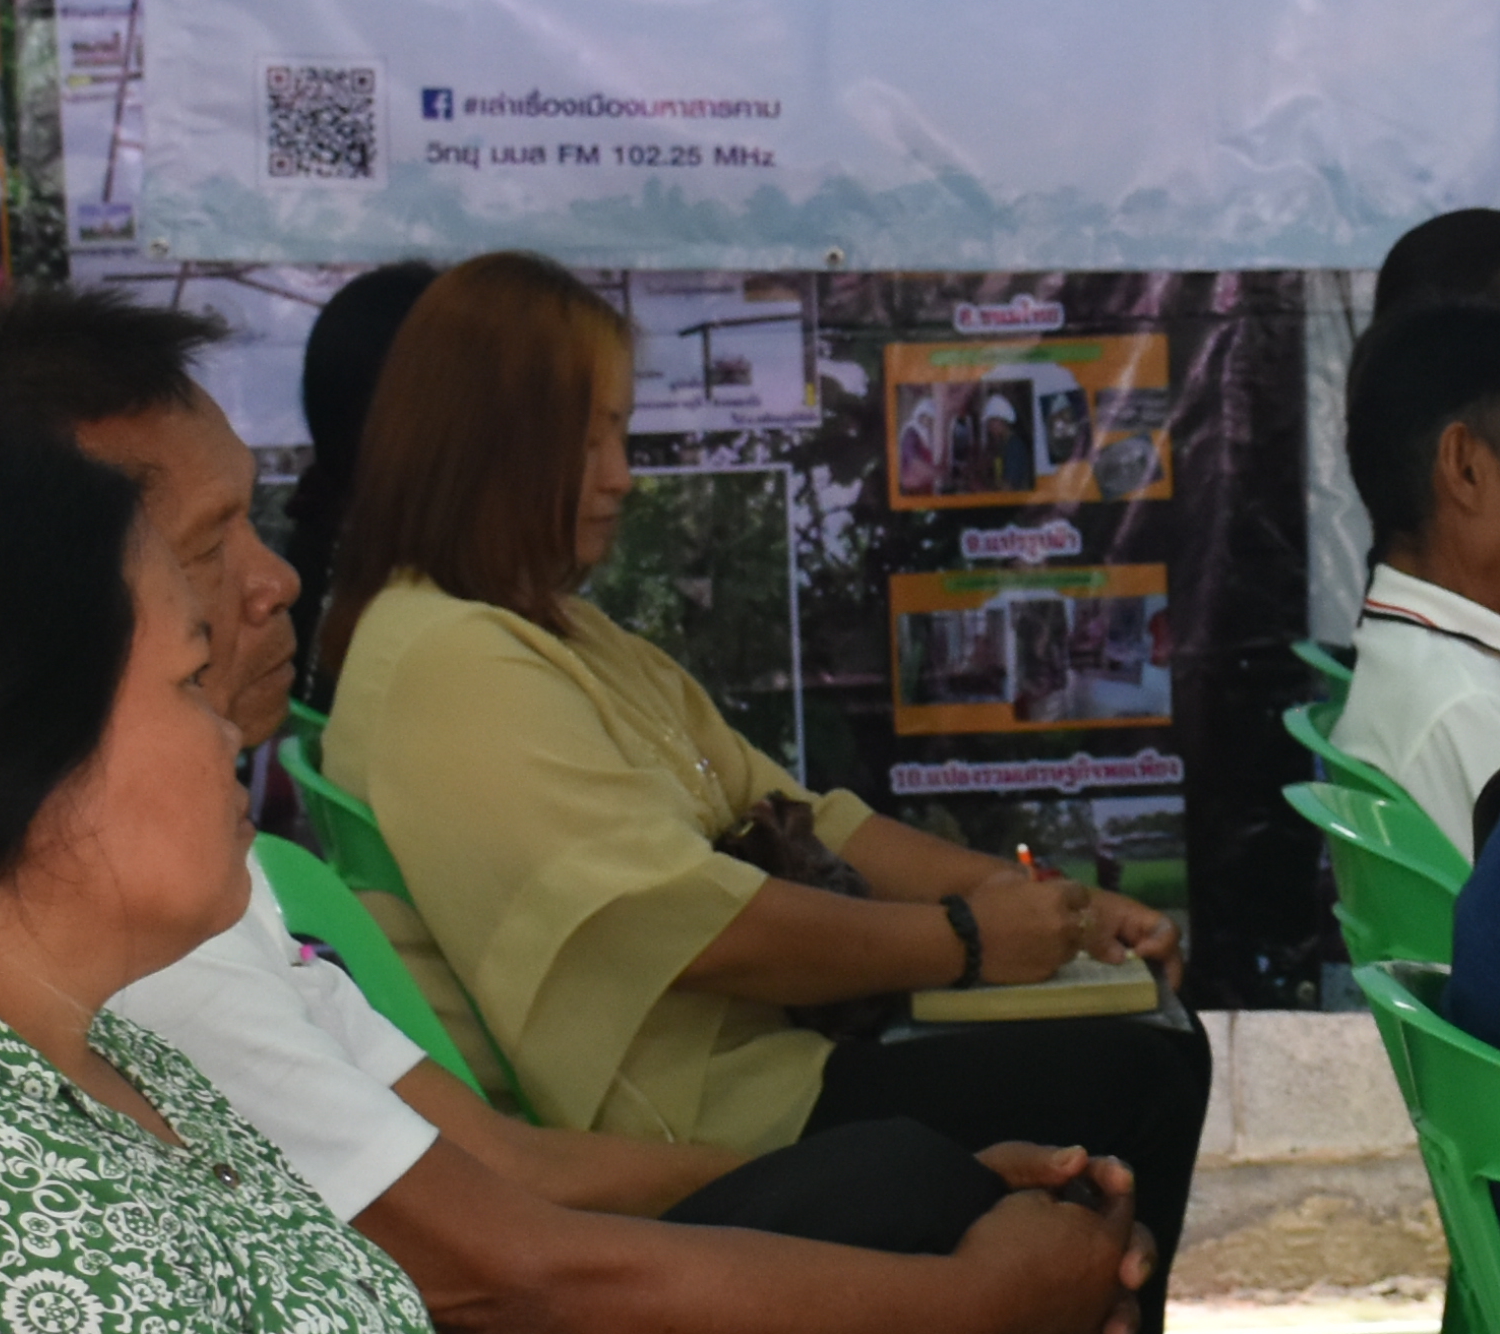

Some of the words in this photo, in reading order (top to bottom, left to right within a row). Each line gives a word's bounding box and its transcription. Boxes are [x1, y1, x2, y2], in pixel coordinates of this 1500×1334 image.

[425, 142, 481, 169] วิทยุ
[557, 144, 600, 166] FM
[613, 145, 703, 167] 102.25
[713, 145, 777, 168] MHz
